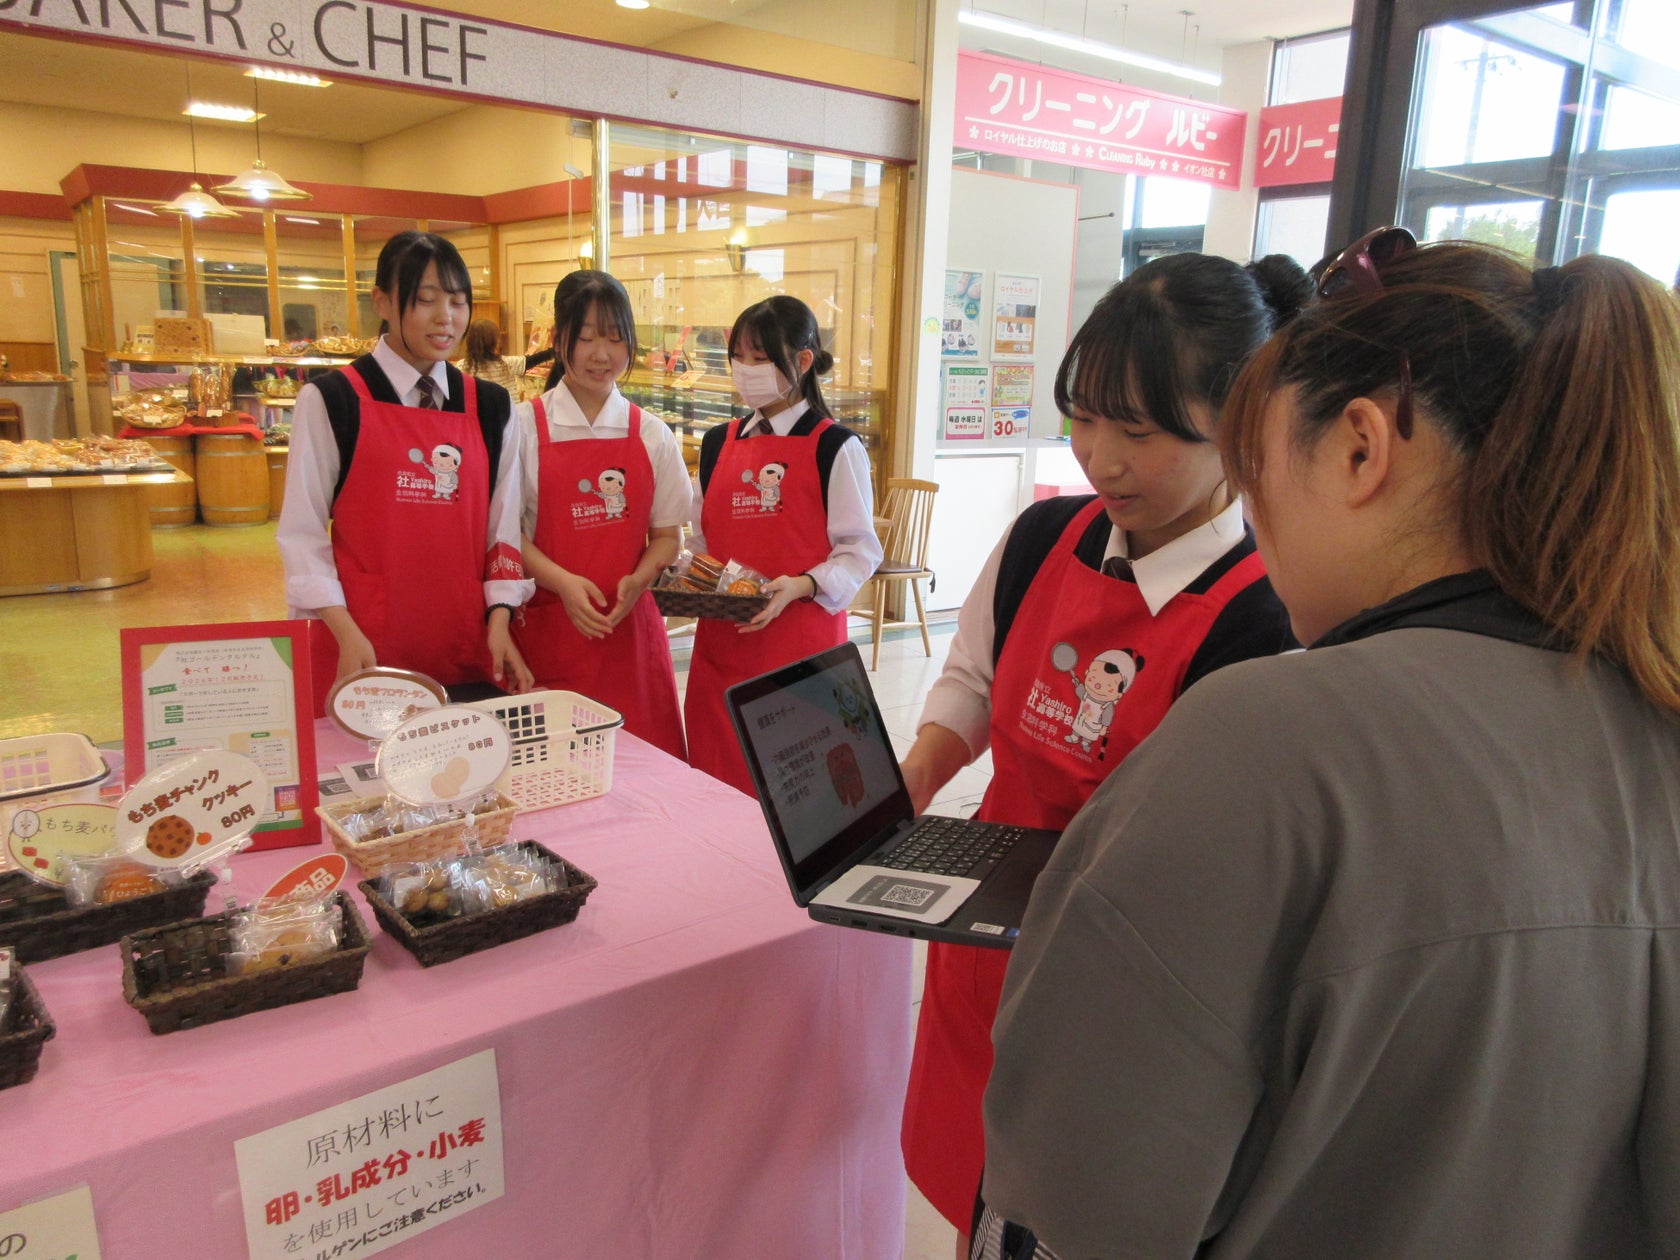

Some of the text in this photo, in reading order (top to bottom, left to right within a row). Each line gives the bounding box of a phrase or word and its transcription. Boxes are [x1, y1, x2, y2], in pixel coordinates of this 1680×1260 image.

[267, 22, 296, 58] &
[313, 0, 488, 86] CHEF
[988, 71, 1218, 152] クリーニング ルビー
[983, 129, 1067, 155] ロイヤル仕上げのお店
[1134, 153, 1156, 170] Ruby
[1183, 163, 1216, 180] イオン社店
[397, 475, 410, 488] 社
[1027, 686, 1039, 709] 社
[1040, 691, 1073, 714] Yashiro
[396, 714, 482, 742] もち麦ビスケット
[127, 768, 221, 825] もち麦チャンク
[201, 779, 253, 812] クッキー
[220, 803, 256, 829] 80円
[116, 887, 151, 898] ひょうご
[305, 1095, 444, 1169] 原材料に
[265, 1117, 487, 1226] 卵・乳成分・小麦
[283, 1159, 481, 1253] を使用しています
[300, 1182, 487, 1260] ルゲンにご注意ください。
